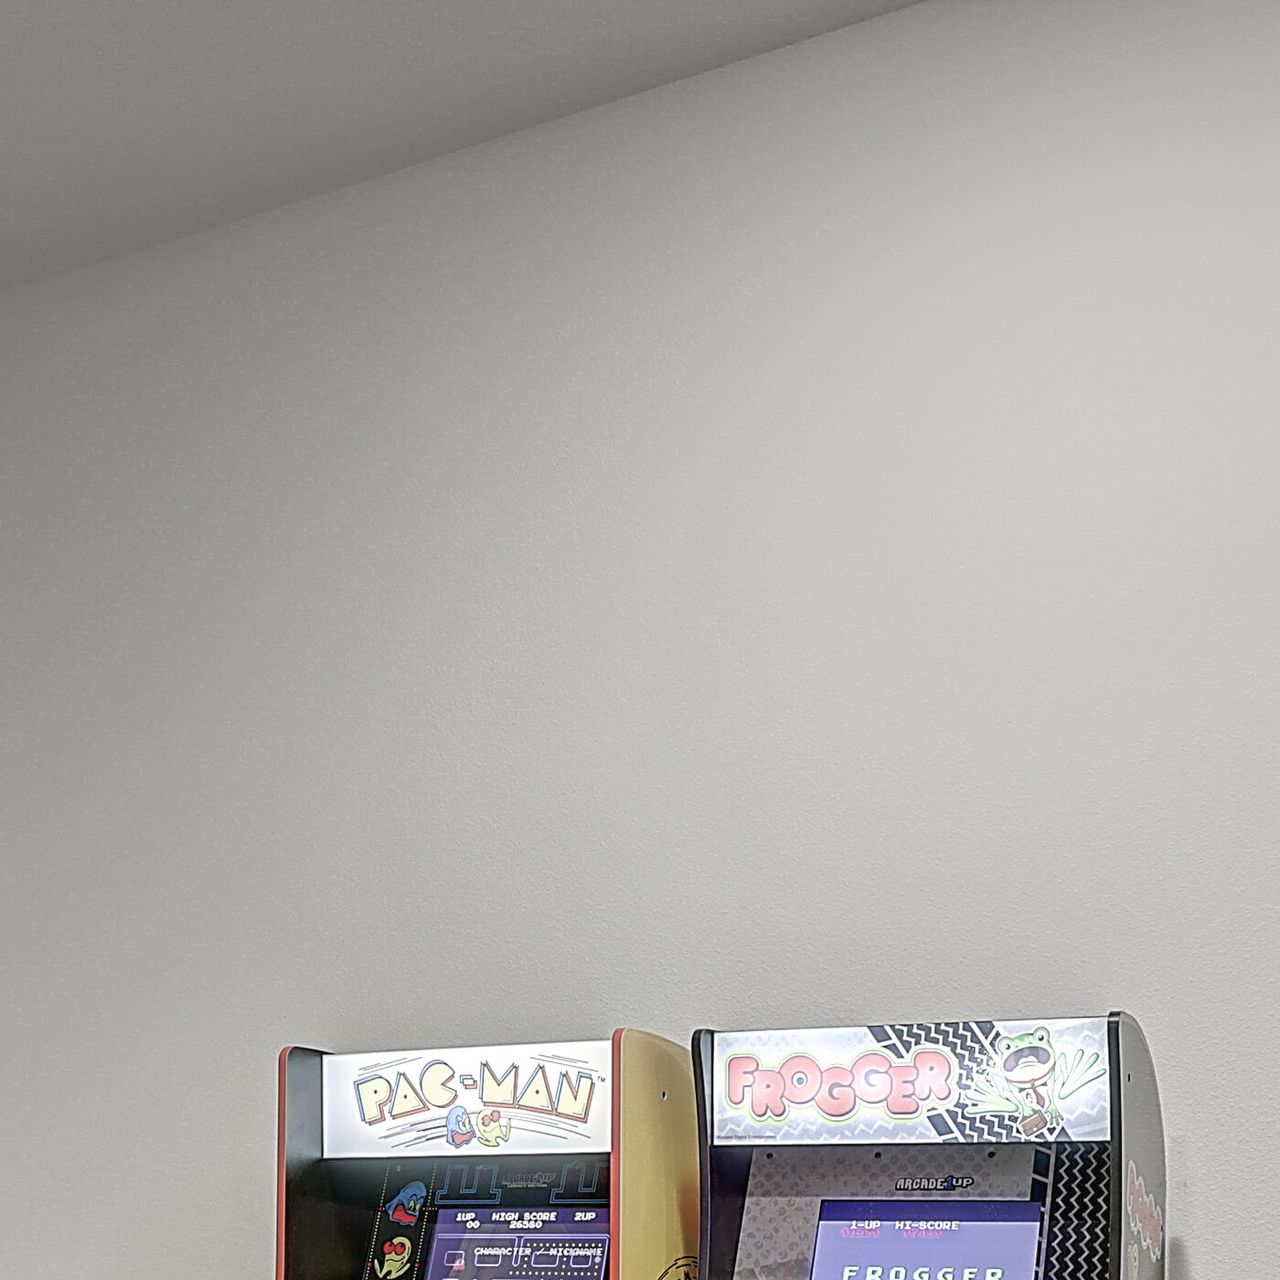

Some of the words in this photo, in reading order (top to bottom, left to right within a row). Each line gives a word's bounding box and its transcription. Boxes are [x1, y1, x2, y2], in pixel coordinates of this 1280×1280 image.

[727, 1050, 952, 1117] FROGGER
[353, 1059, 596, 1126] PAC-MAN
[456, 1212, 476, 1222] 1UP
[491, 1212, 519, 1222] HIGH
[523, 1212, 558, 1222] SCORE
[574, 1212, 597, 1222] 2UP
[850, 1220, 881, 1230] 1-UP
[895, 1221, 960, 1231] HI-SCORE
[474, 1247, 532, 1256] CHARACTER
